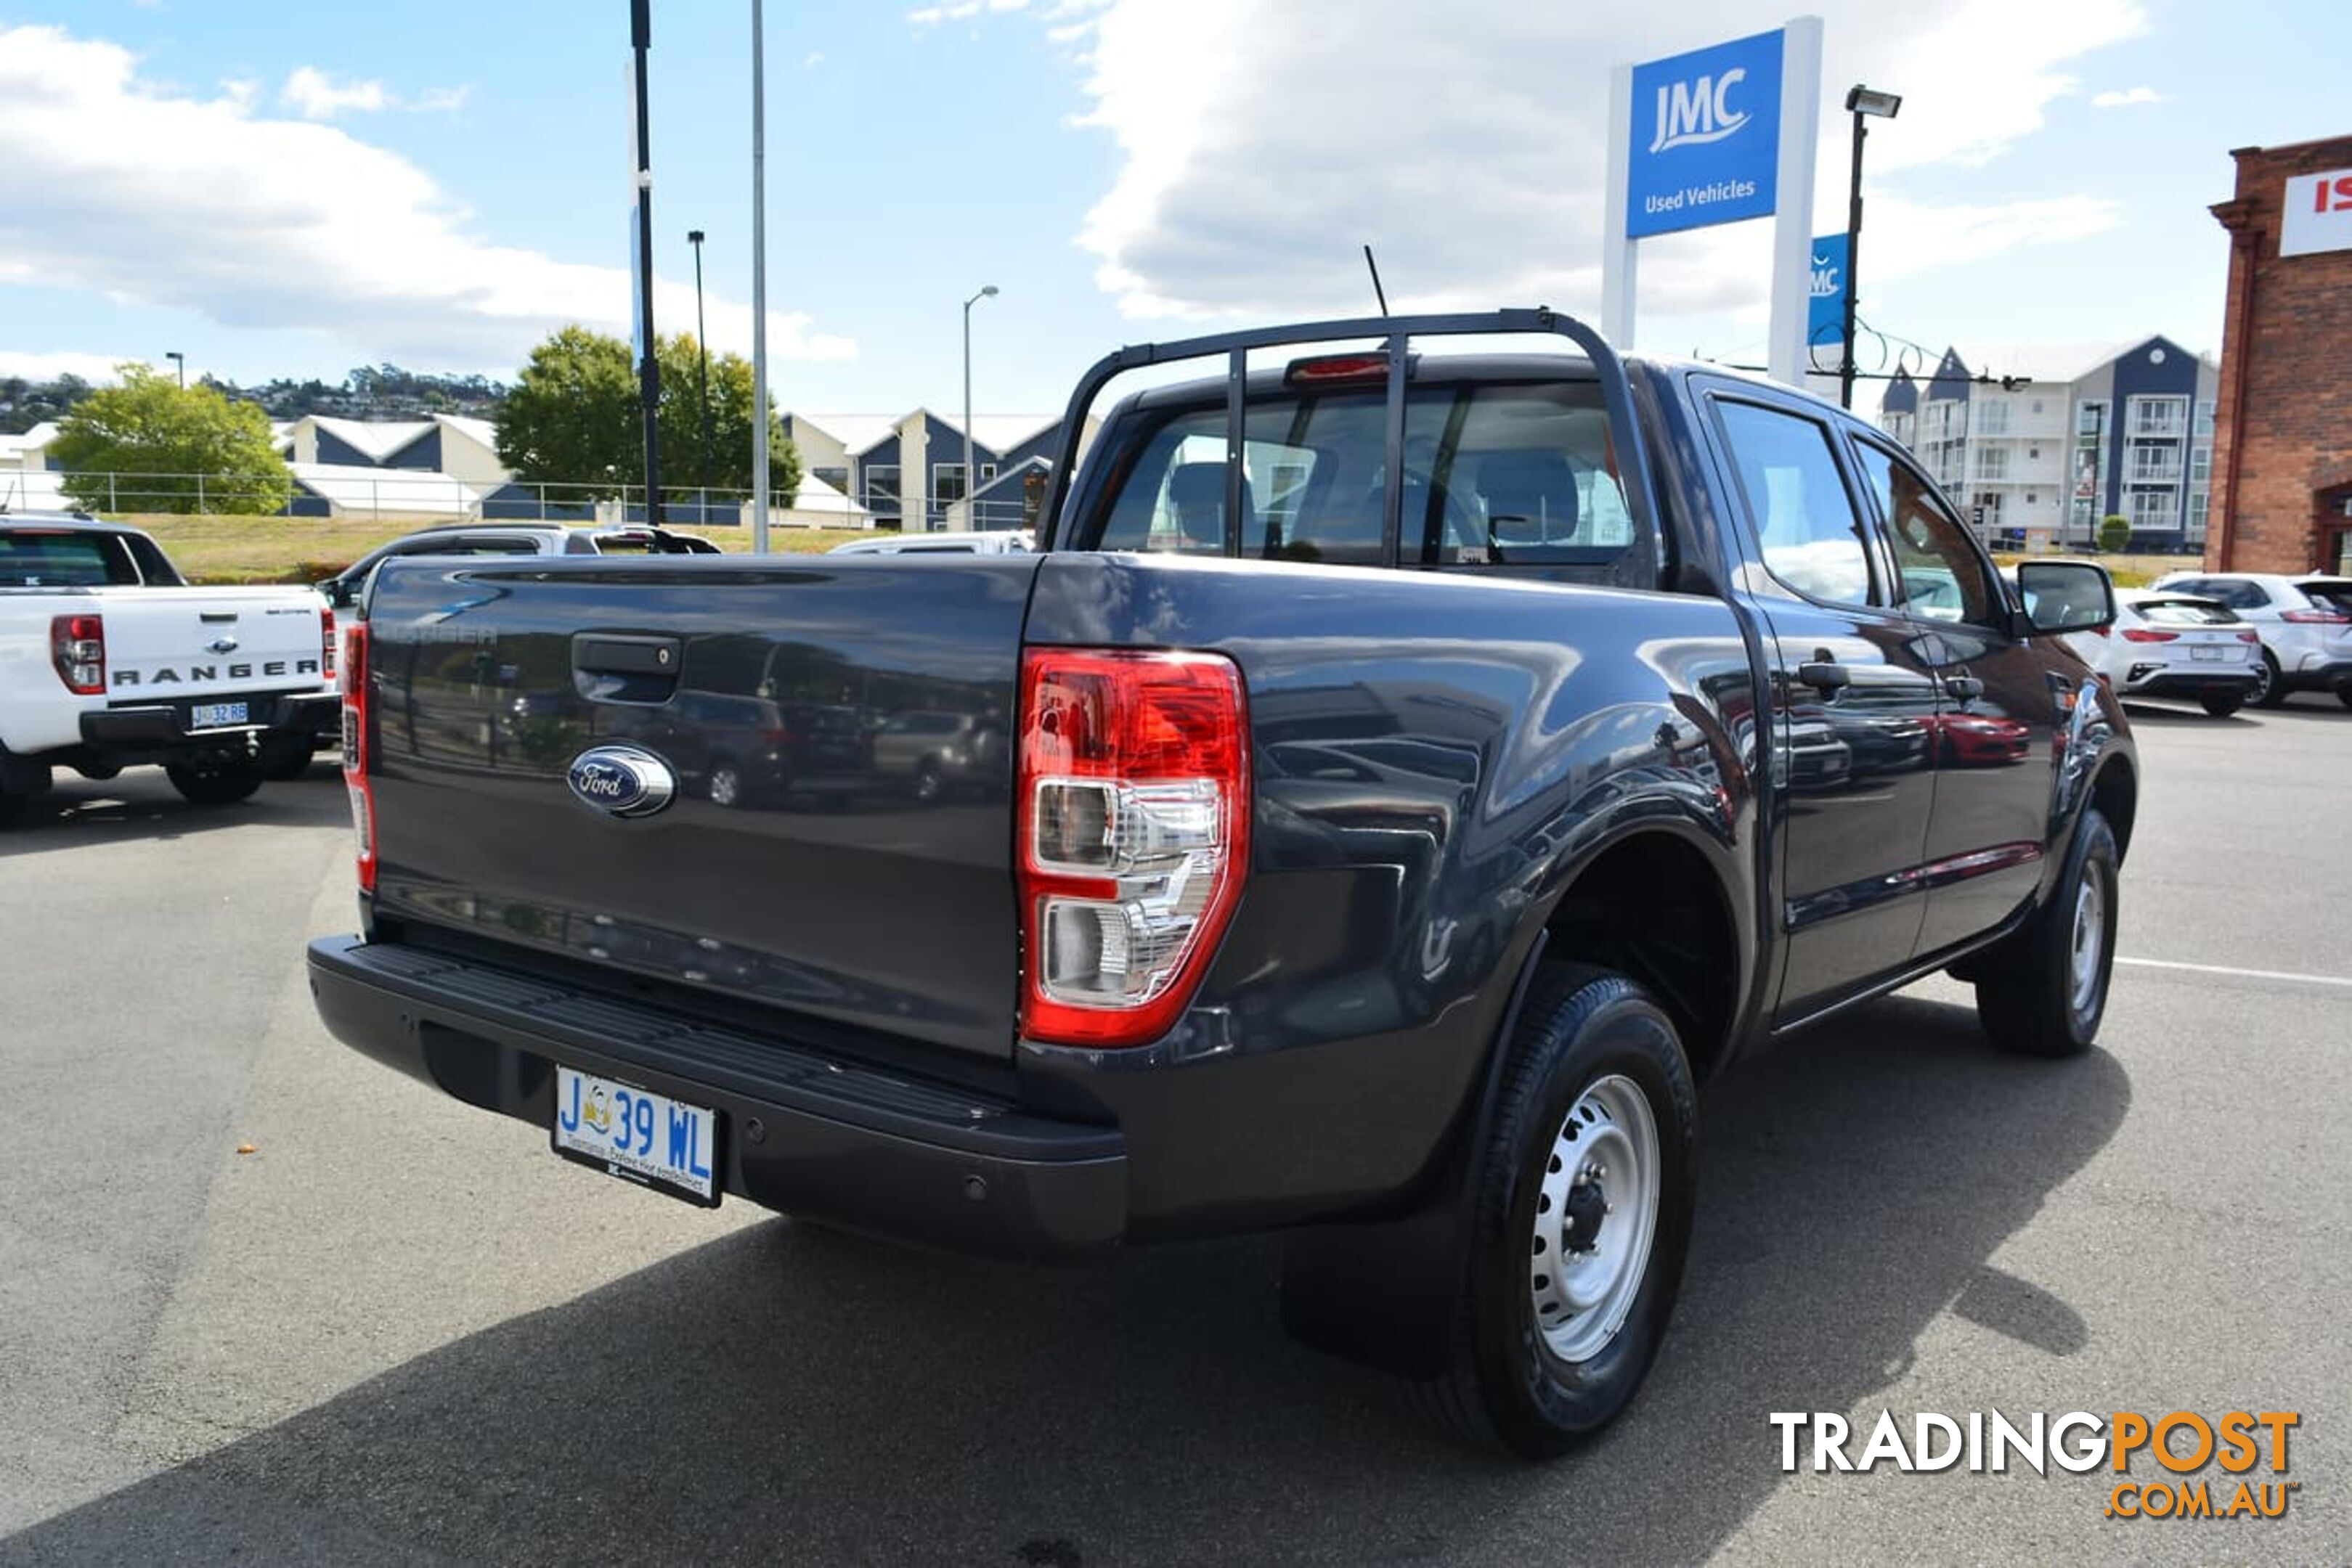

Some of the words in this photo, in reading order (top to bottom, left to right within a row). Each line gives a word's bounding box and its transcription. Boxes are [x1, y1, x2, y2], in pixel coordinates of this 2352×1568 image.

[1649, 68, 1749, 153] JMC
[1645, 190, 1684, 214] Used
[1686, 179, 1756, 206] Vehicles
[113, 660, 318, 686] RANGER
[579, 763, 623, 796] Ford
[561, 1076, 580, 1132] J
[614, 1090, 654, 1156] 39
[668, 1105, 710, 1180] WL
